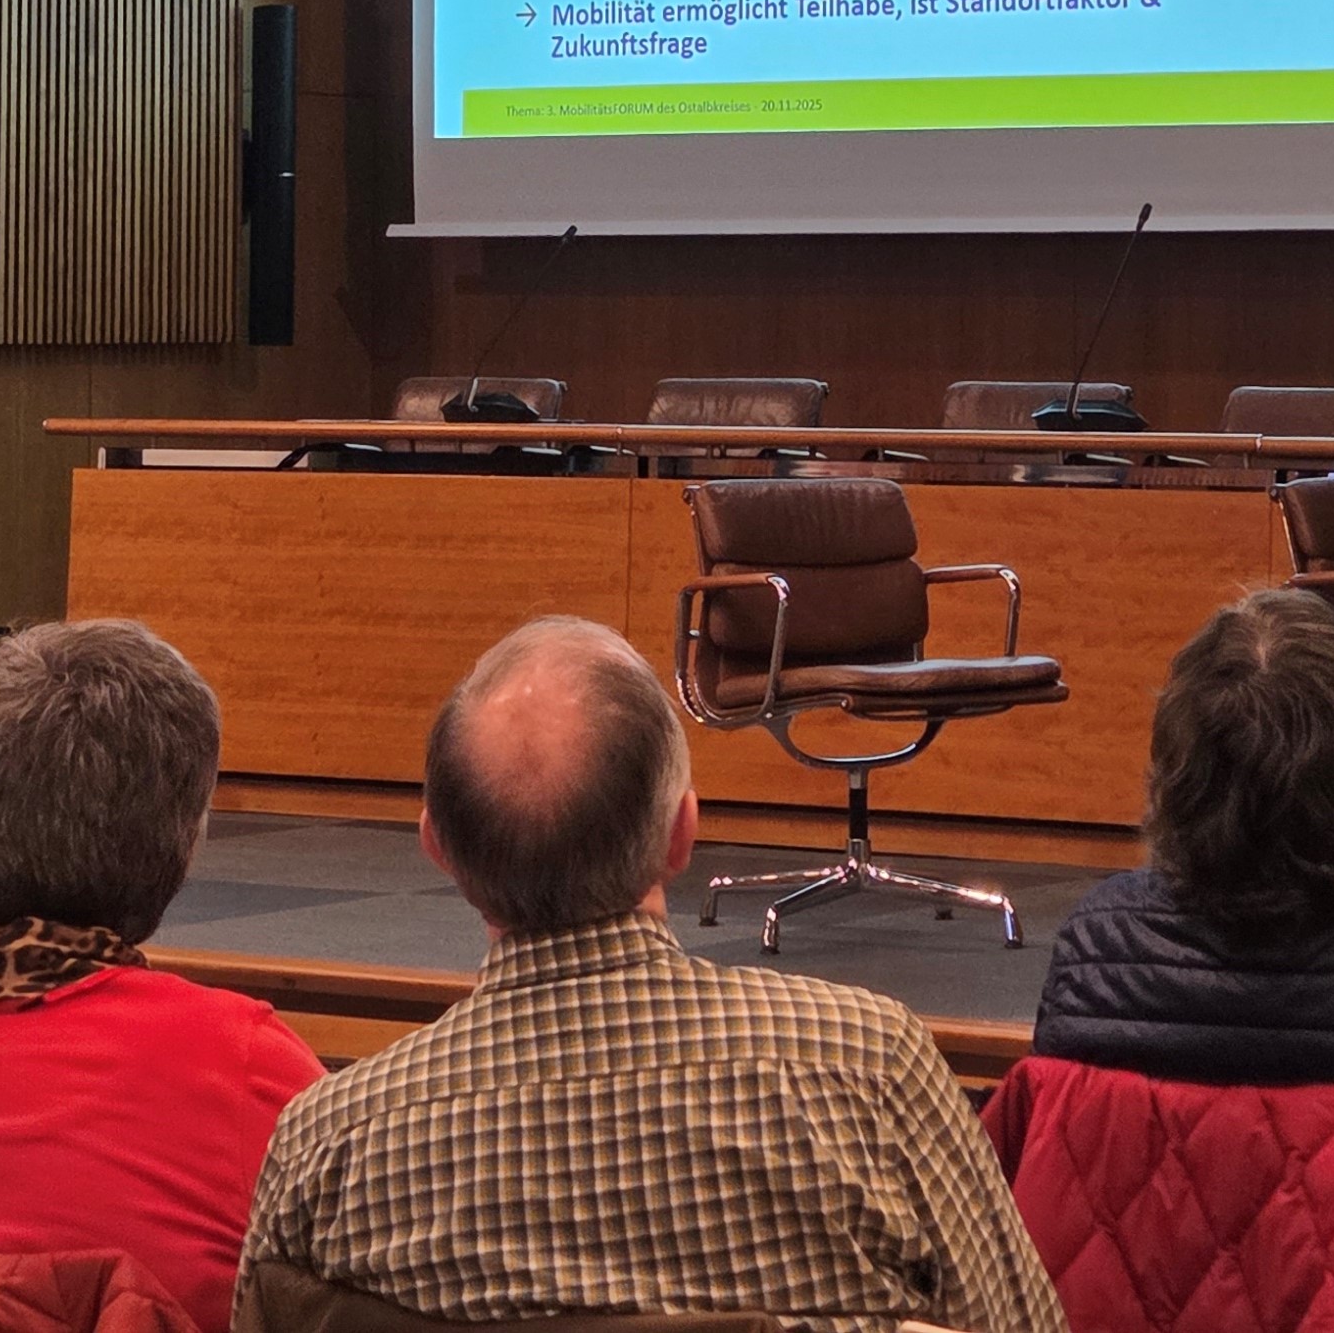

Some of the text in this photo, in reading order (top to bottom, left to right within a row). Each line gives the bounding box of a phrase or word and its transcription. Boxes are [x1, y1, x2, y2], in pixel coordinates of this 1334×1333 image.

[550, 29, 708, 60] Zukunftsfrage
[504, 104, 545, 117] Thema:
[655, 100, 676, 115] des
[677, 98, 752, 115] Ostalbkreises
[760, 97, 823, 113] 20.11.2025
